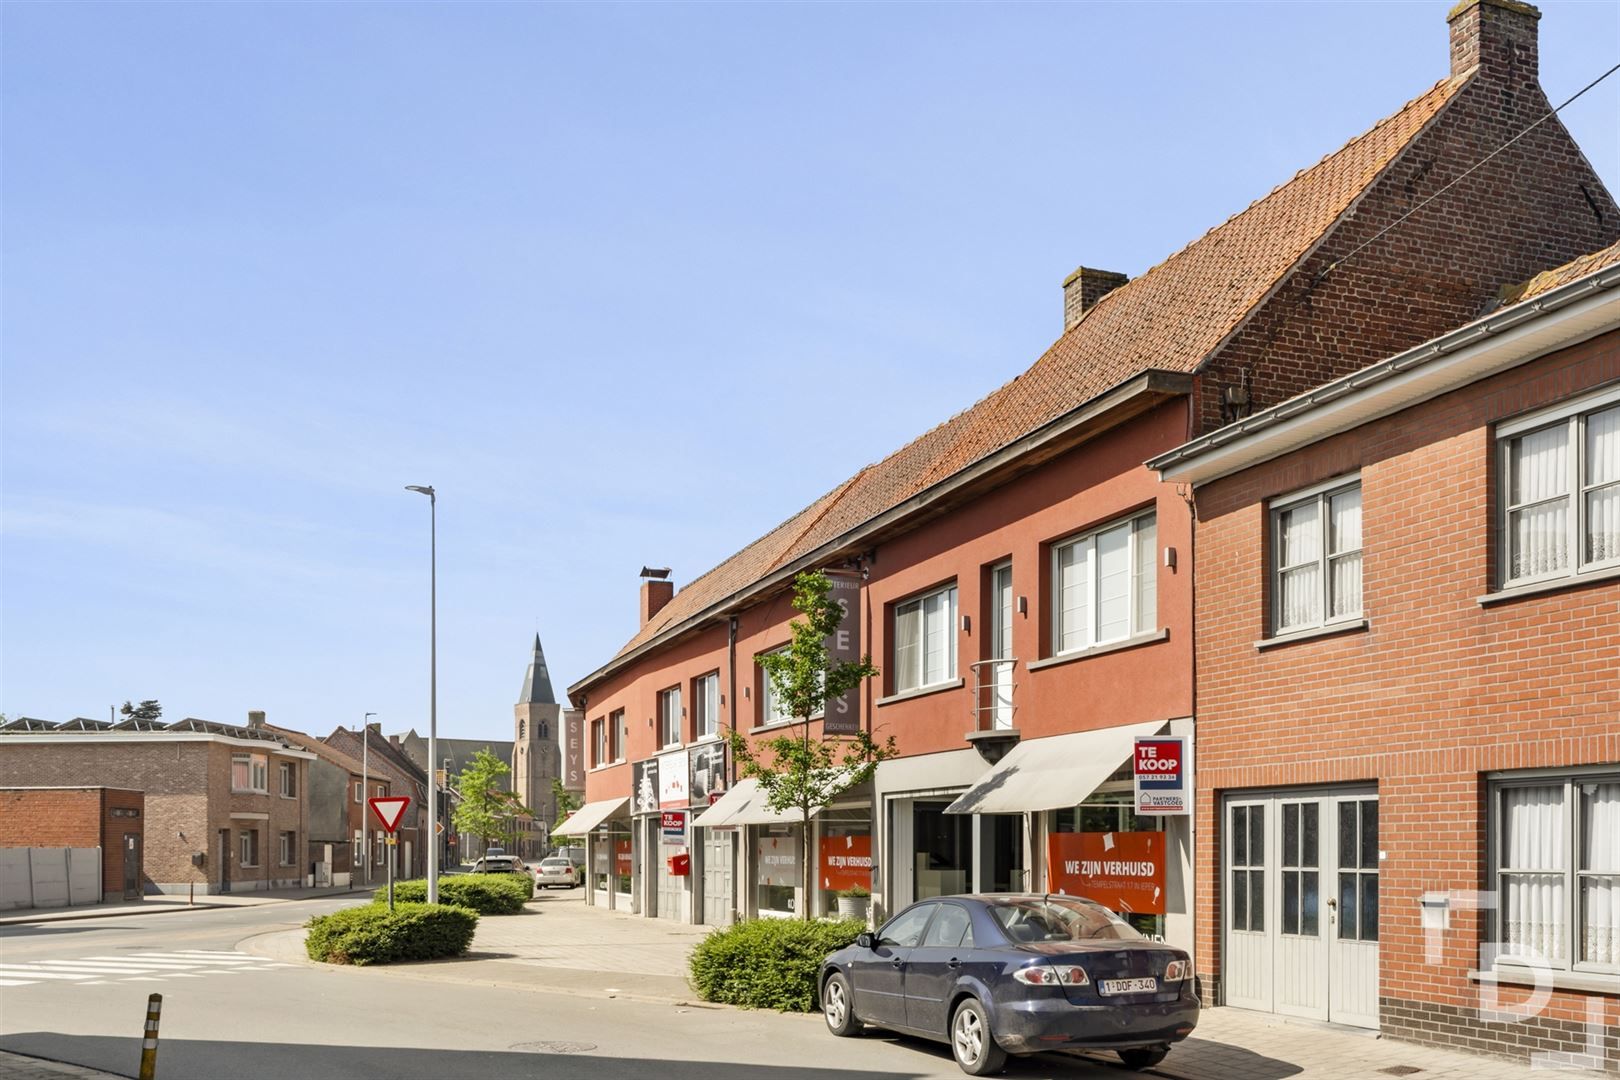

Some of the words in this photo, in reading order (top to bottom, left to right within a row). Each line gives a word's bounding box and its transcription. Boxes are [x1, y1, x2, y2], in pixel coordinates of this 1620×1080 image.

[836, 598, 850, 714] SES
[570, 721, 578, 782] SEYS
[1139, 747, 1157, 758] TE
[1139, 759, 1178, 771] KOOP
[828, 855, 836, 866] WE
[836, 856, 846, 869] ZIJN
[846, 856, 872, 867] VERHUISD
[1065, 860, 1080, 874] WE
[1081, 861, 1101, 878] ZIJN
[1103, 861, 1155, 877] VERHUISD
[1105, 979, 1156, 992] 1-DOF-340
